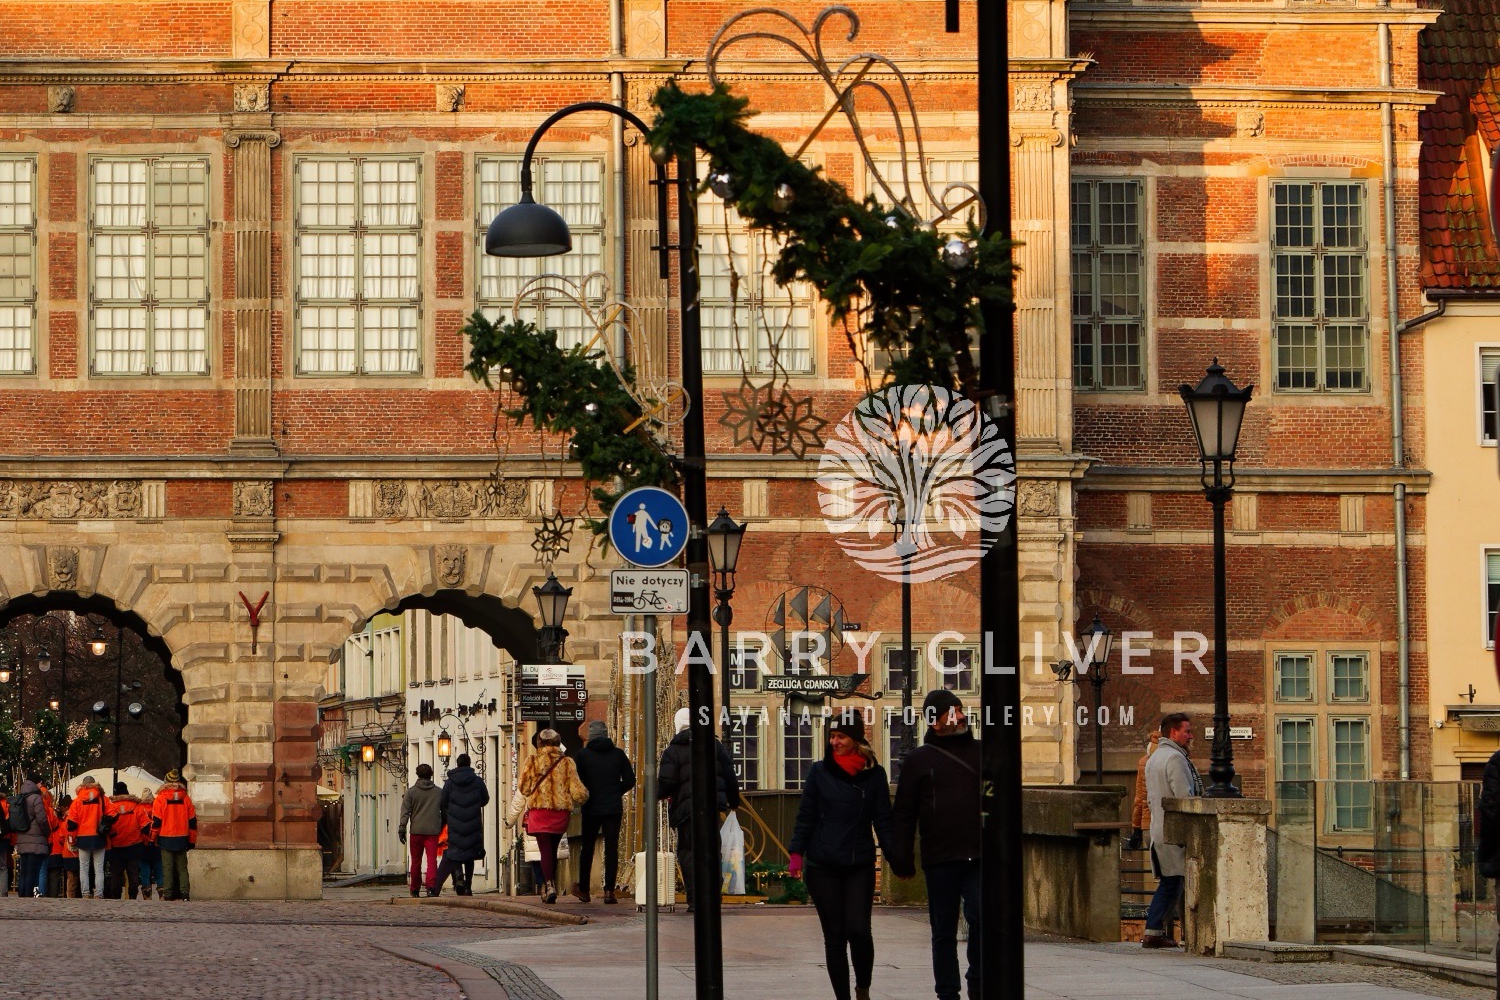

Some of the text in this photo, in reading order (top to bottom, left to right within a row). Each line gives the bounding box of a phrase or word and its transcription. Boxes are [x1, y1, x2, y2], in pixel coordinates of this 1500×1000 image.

[616, 576, 684, 588] Nie dotyczy
[730, 653, 743, 790] MUZEU
